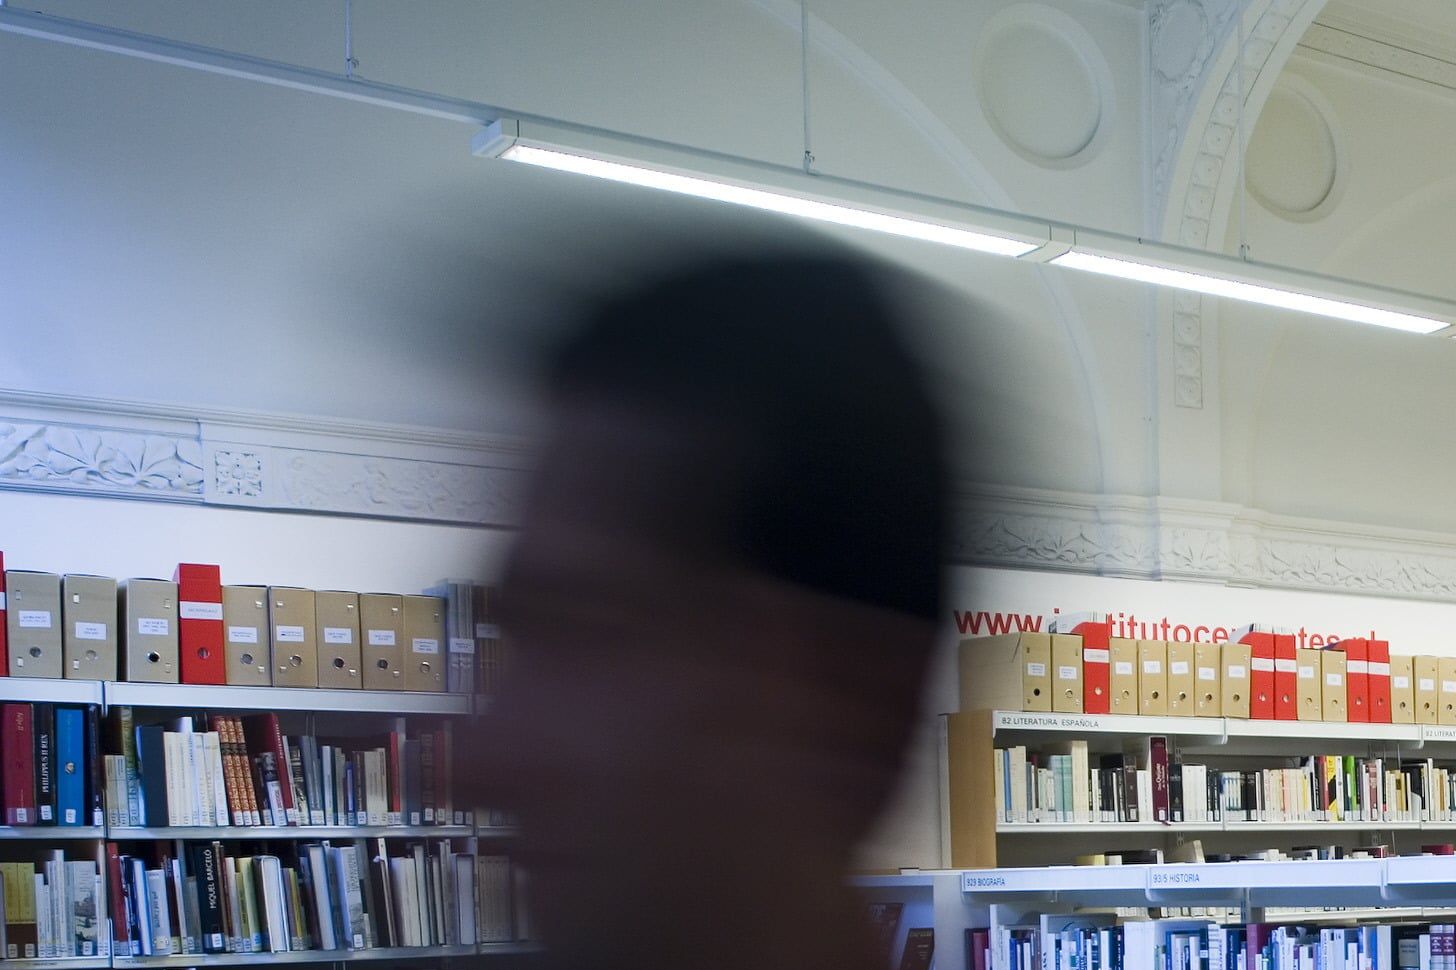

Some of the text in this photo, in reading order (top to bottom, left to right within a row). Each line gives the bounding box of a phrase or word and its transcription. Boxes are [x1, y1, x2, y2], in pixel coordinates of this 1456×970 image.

[1001, 717, 1099, 728] 82 LITERATURA ESPAÑOLA
[203, 849, 214, 881] BARCELÓ
[967, 878, 976, 887] 929
[1169, 872, 1200, 883] HISTORIA
